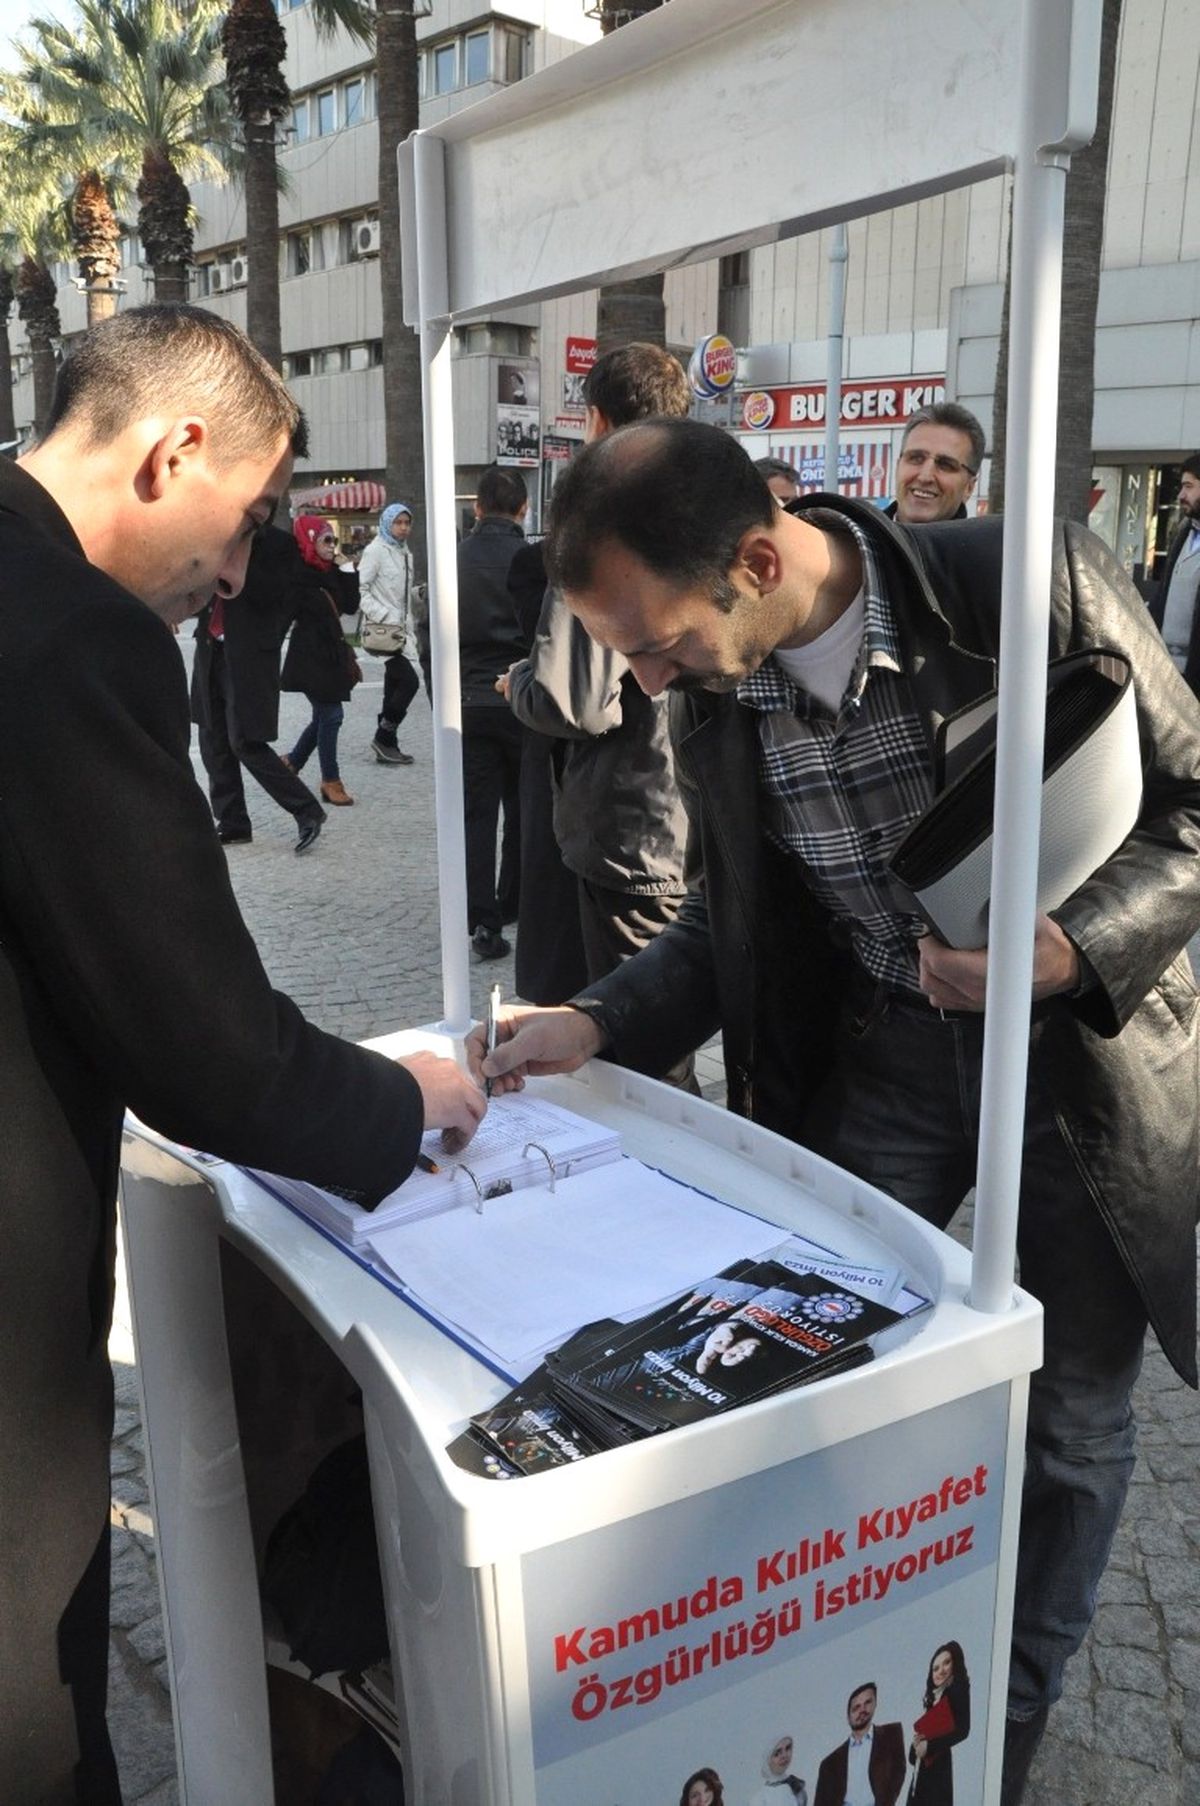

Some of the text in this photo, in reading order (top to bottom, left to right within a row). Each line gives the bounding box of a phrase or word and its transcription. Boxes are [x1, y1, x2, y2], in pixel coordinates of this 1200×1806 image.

[706, 347, 733, 362] BURGER
[706, 357, 735, 377] KING
[790, 388, 897, 422] BUGER
[499, 447, 538, 457] POLICE
[819, 1268, 867, 1284] Milyon
[868, 1277, 884, 1287] 10
[671, 1368, 713, 1397] Milyon
[706, 1392, 728, 1405] 10
[553, 1464, 988, 1674] Kamuda Kılık Kıyafet
[571, 1524, 975, 1722] Özgürlüğü İstiyoruz
